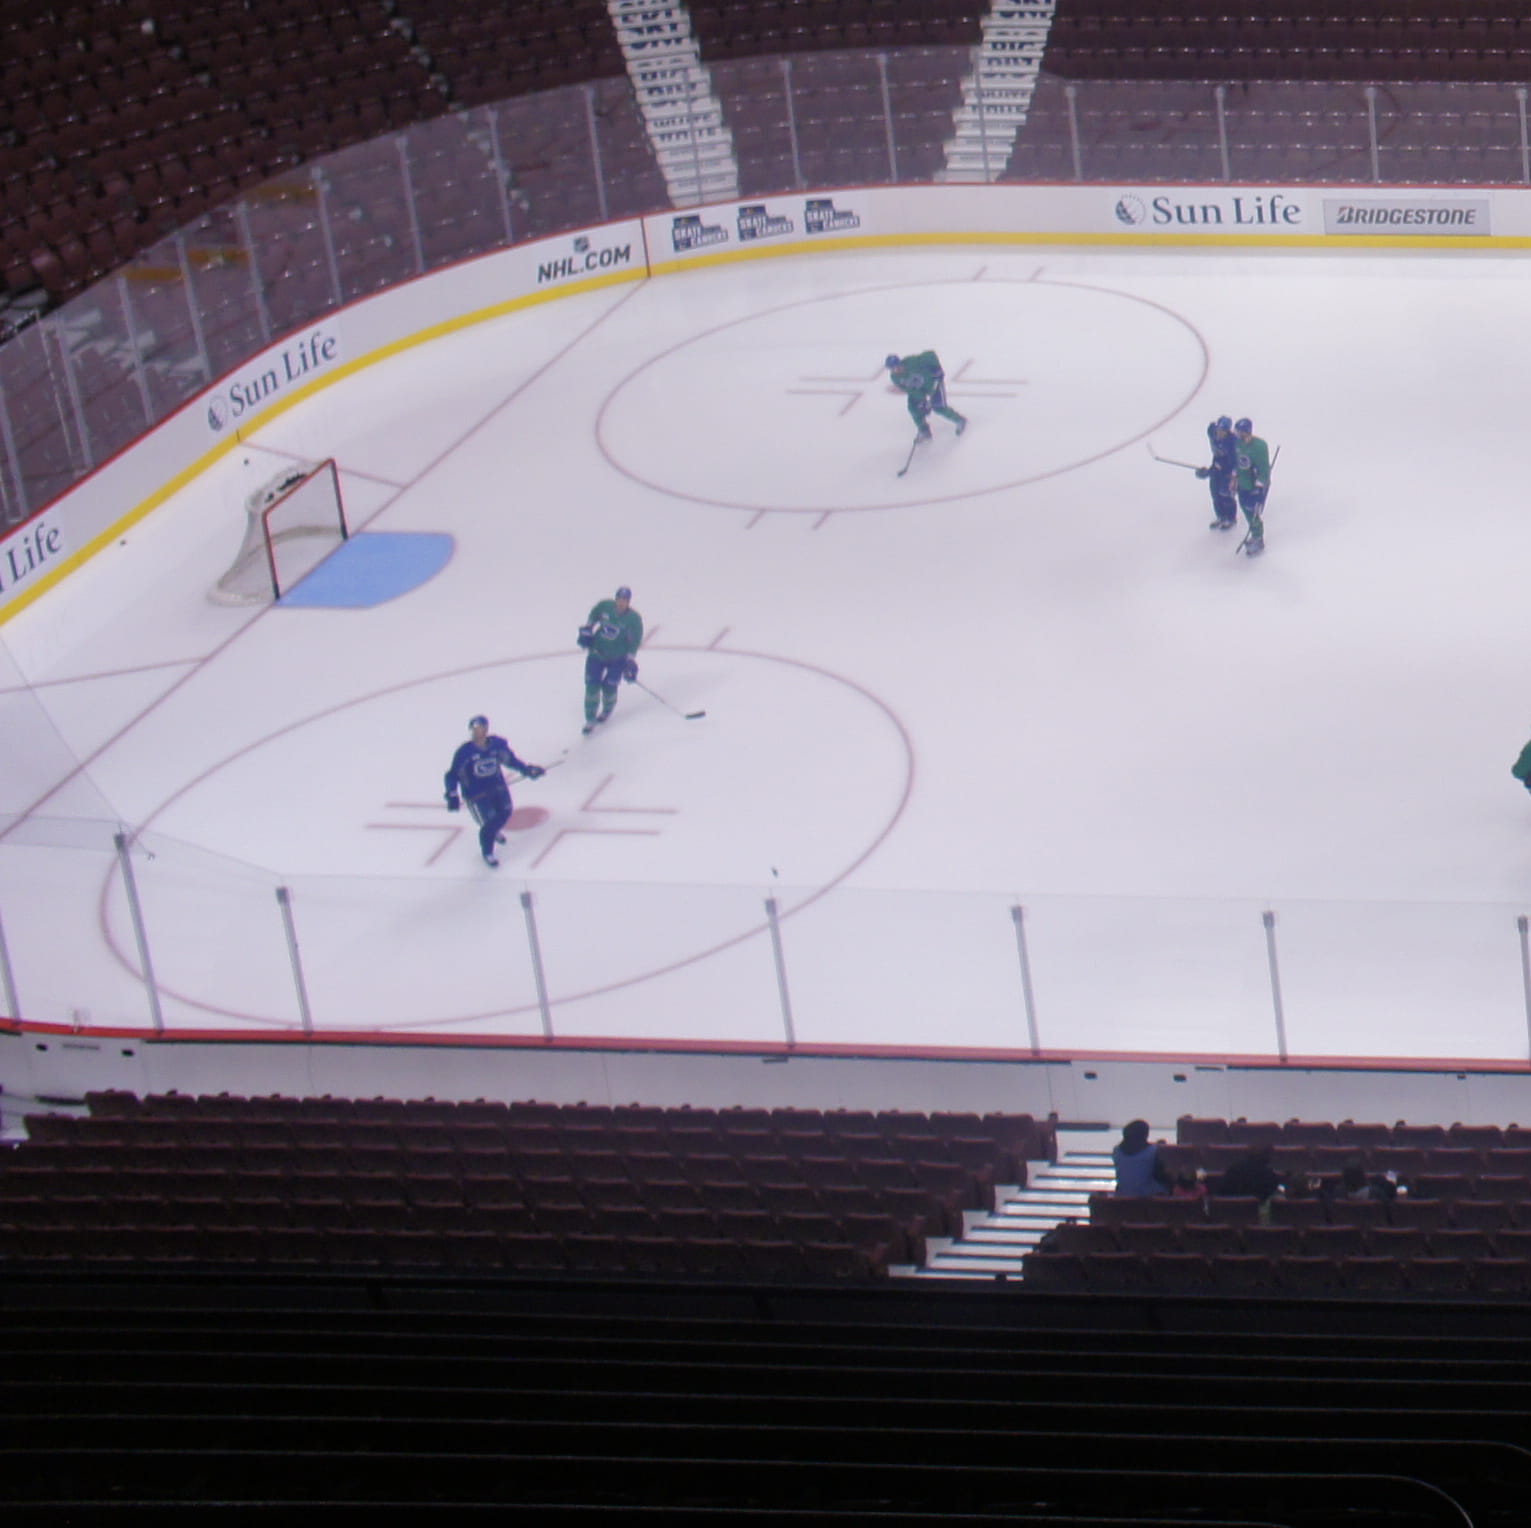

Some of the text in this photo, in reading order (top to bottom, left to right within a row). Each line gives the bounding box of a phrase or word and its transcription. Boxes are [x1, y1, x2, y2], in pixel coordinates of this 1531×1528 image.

[1151, 194, 1301, 225] Sun Life
[1336, 206, 1476, 225] BRIDGESTONE
[537, 243, 631, 284] NHL.COM
[228, 331, 337, 418] Sun Life
[5, 522, 62, 585] Life
